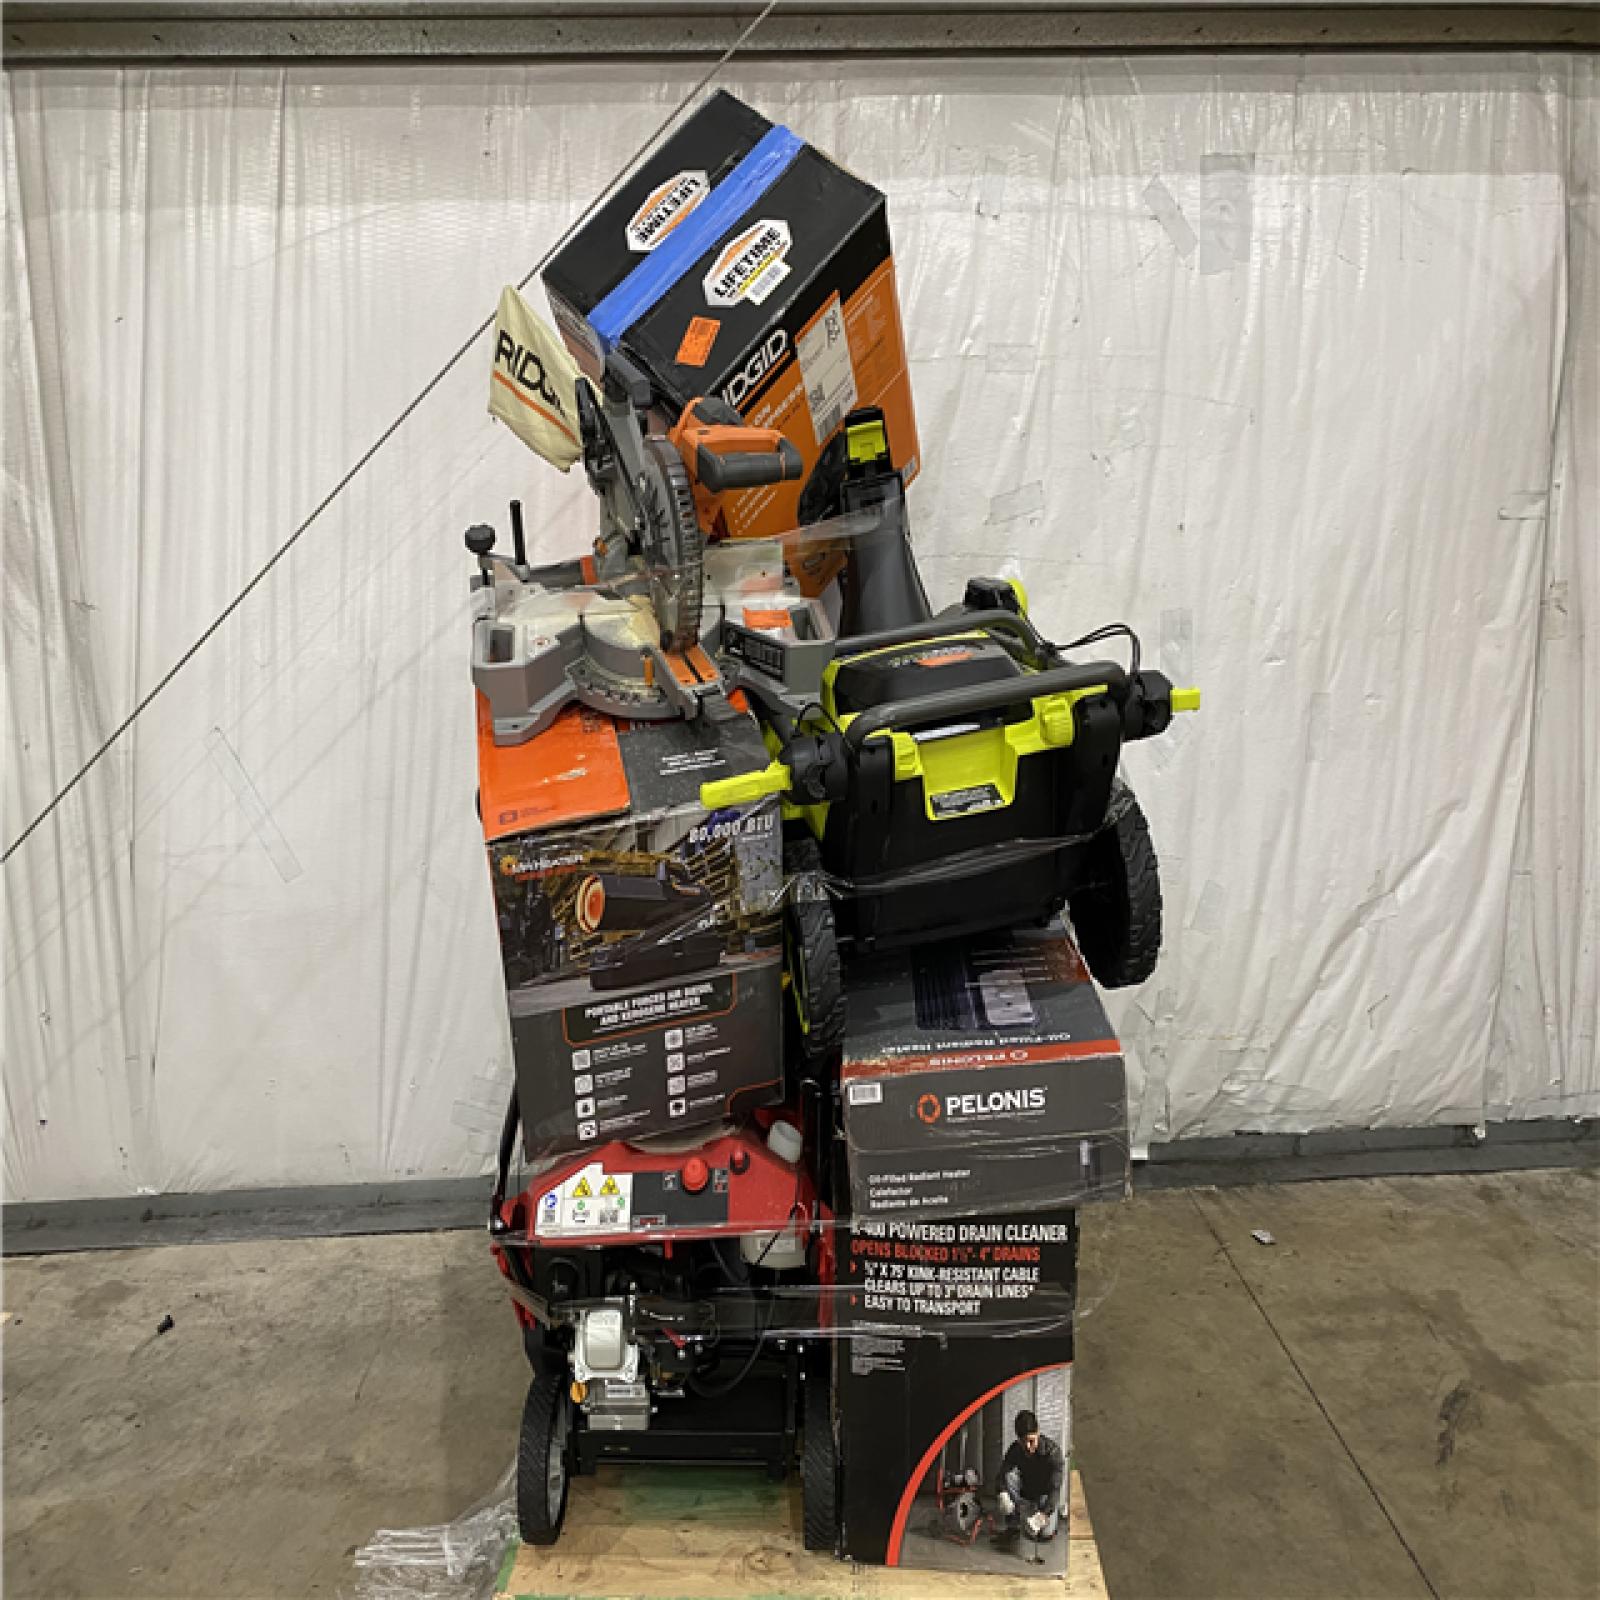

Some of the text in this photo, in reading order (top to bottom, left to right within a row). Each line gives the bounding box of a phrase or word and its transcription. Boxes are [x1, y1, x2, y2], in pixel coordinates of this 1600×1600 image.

[635, 176, 701, 245] LIFETIME
[713, 226, 780, 298] LIFETIME
[945, 1088, 1046, 1116] PELONIS
[889, 1222, 957, 1242] POWERED
[959, 1224, 1003, 1243] DRAIN
[1005, 1224, 1068, 1243] CLEANER
[851, 1239, 891, 1258] OPENS
[894, 1242, 948, 1262] BLOCKED
[993, 1245, 1040, 1263] DRAINS
[1002, 1267, 1040, 1283] CABLE
[864, 1278, 906, 1295] CLEARS
[909, 1281, 925, 1296] UP
[926, 1283, 943, 1298] TO
[957, 1284, 993, 1299] DRAIN
[864, 1294, 981, 1316] EASY TO TRANSPORT
